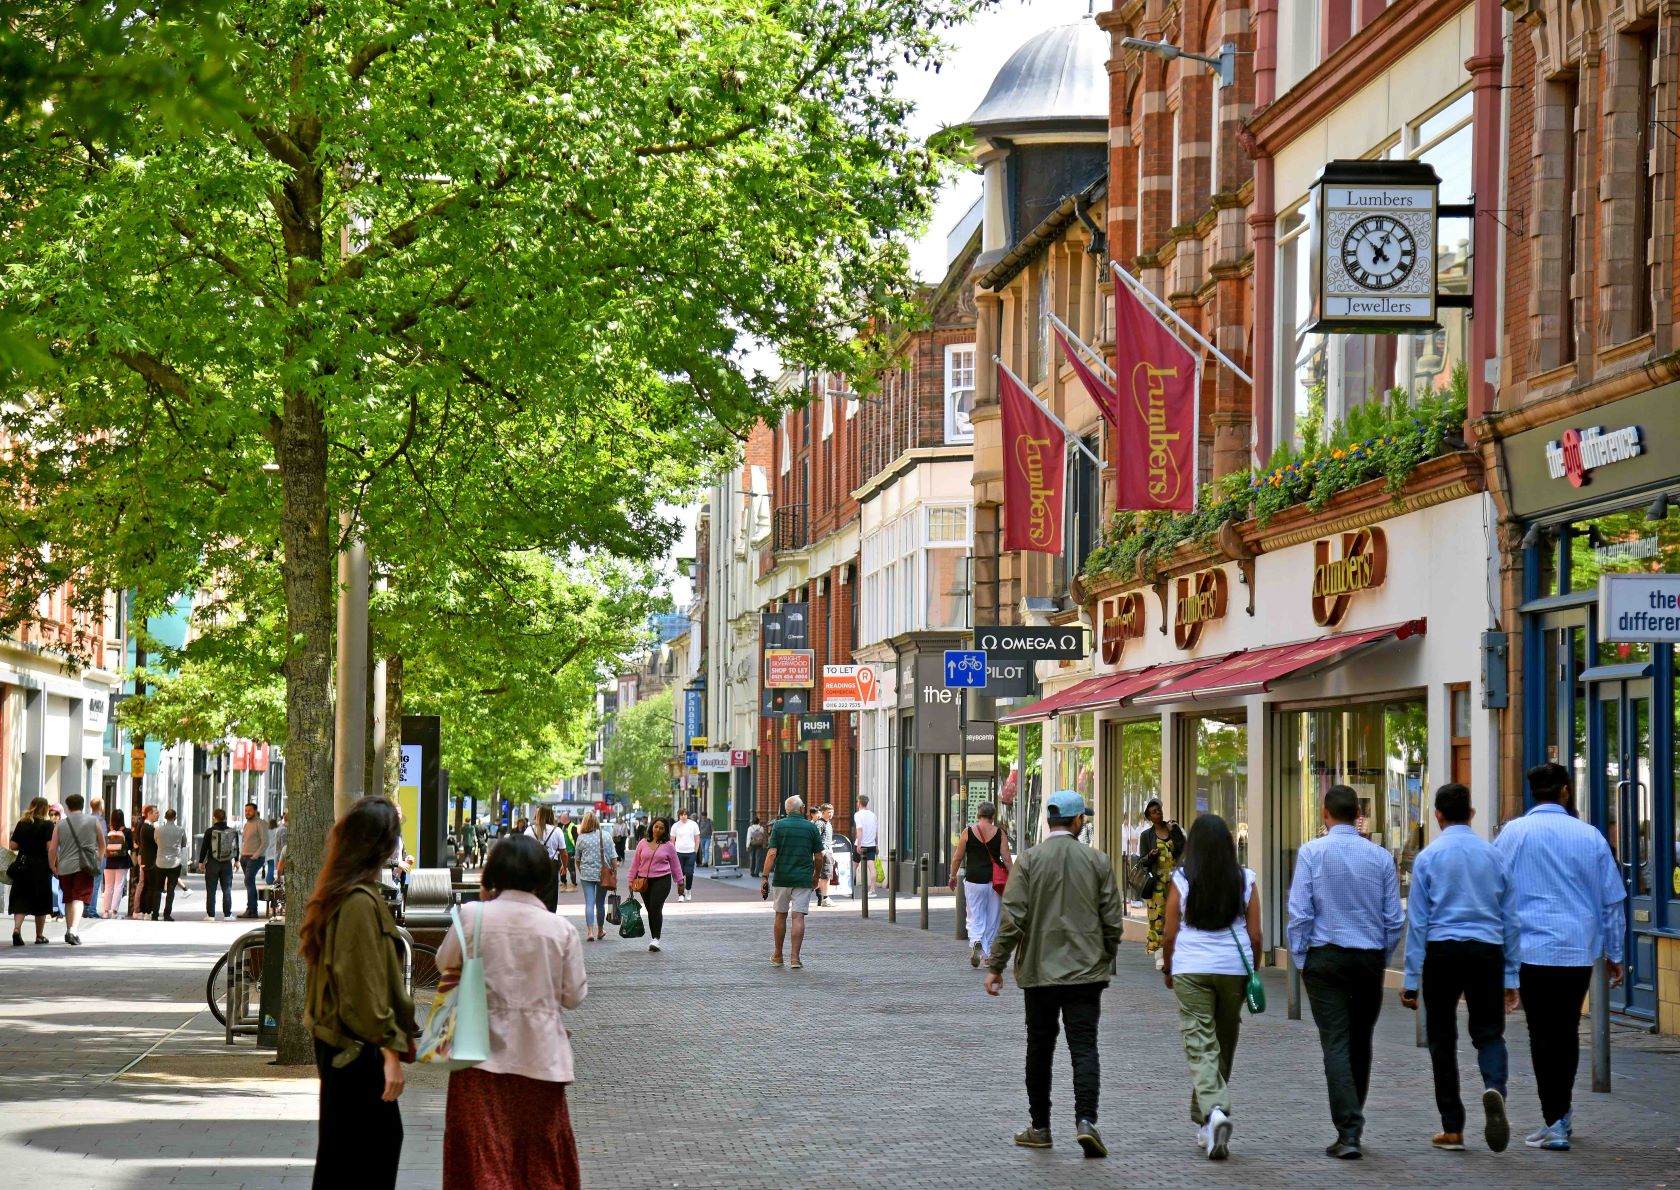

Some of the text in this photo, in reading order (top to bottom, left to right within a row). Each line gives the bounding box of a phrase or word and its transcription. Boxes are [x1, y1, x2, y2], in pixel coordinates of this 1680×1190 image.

[1346, 190, 1413, 206] Lumbers
[1344, 297, 1412, 316] Jewellers
[1142, 364, 1180, 499] Lumbers
[1021, 436, 1054, 543] Lumbers
[1312, 533, 1375, 600] Lumbers
[1649, 590, 1677, 609] the
[1001, 637, 1057, 650] OMEGA
[826, 666, 854, 674] TO LET
[862, 671, 869, 680] R
[986, 666, 1025, 679] PILOT
[924, 686, 951, 703] the
[688, 691, 696, 737] Panason
[803, 721, 830, 730] RUSH
